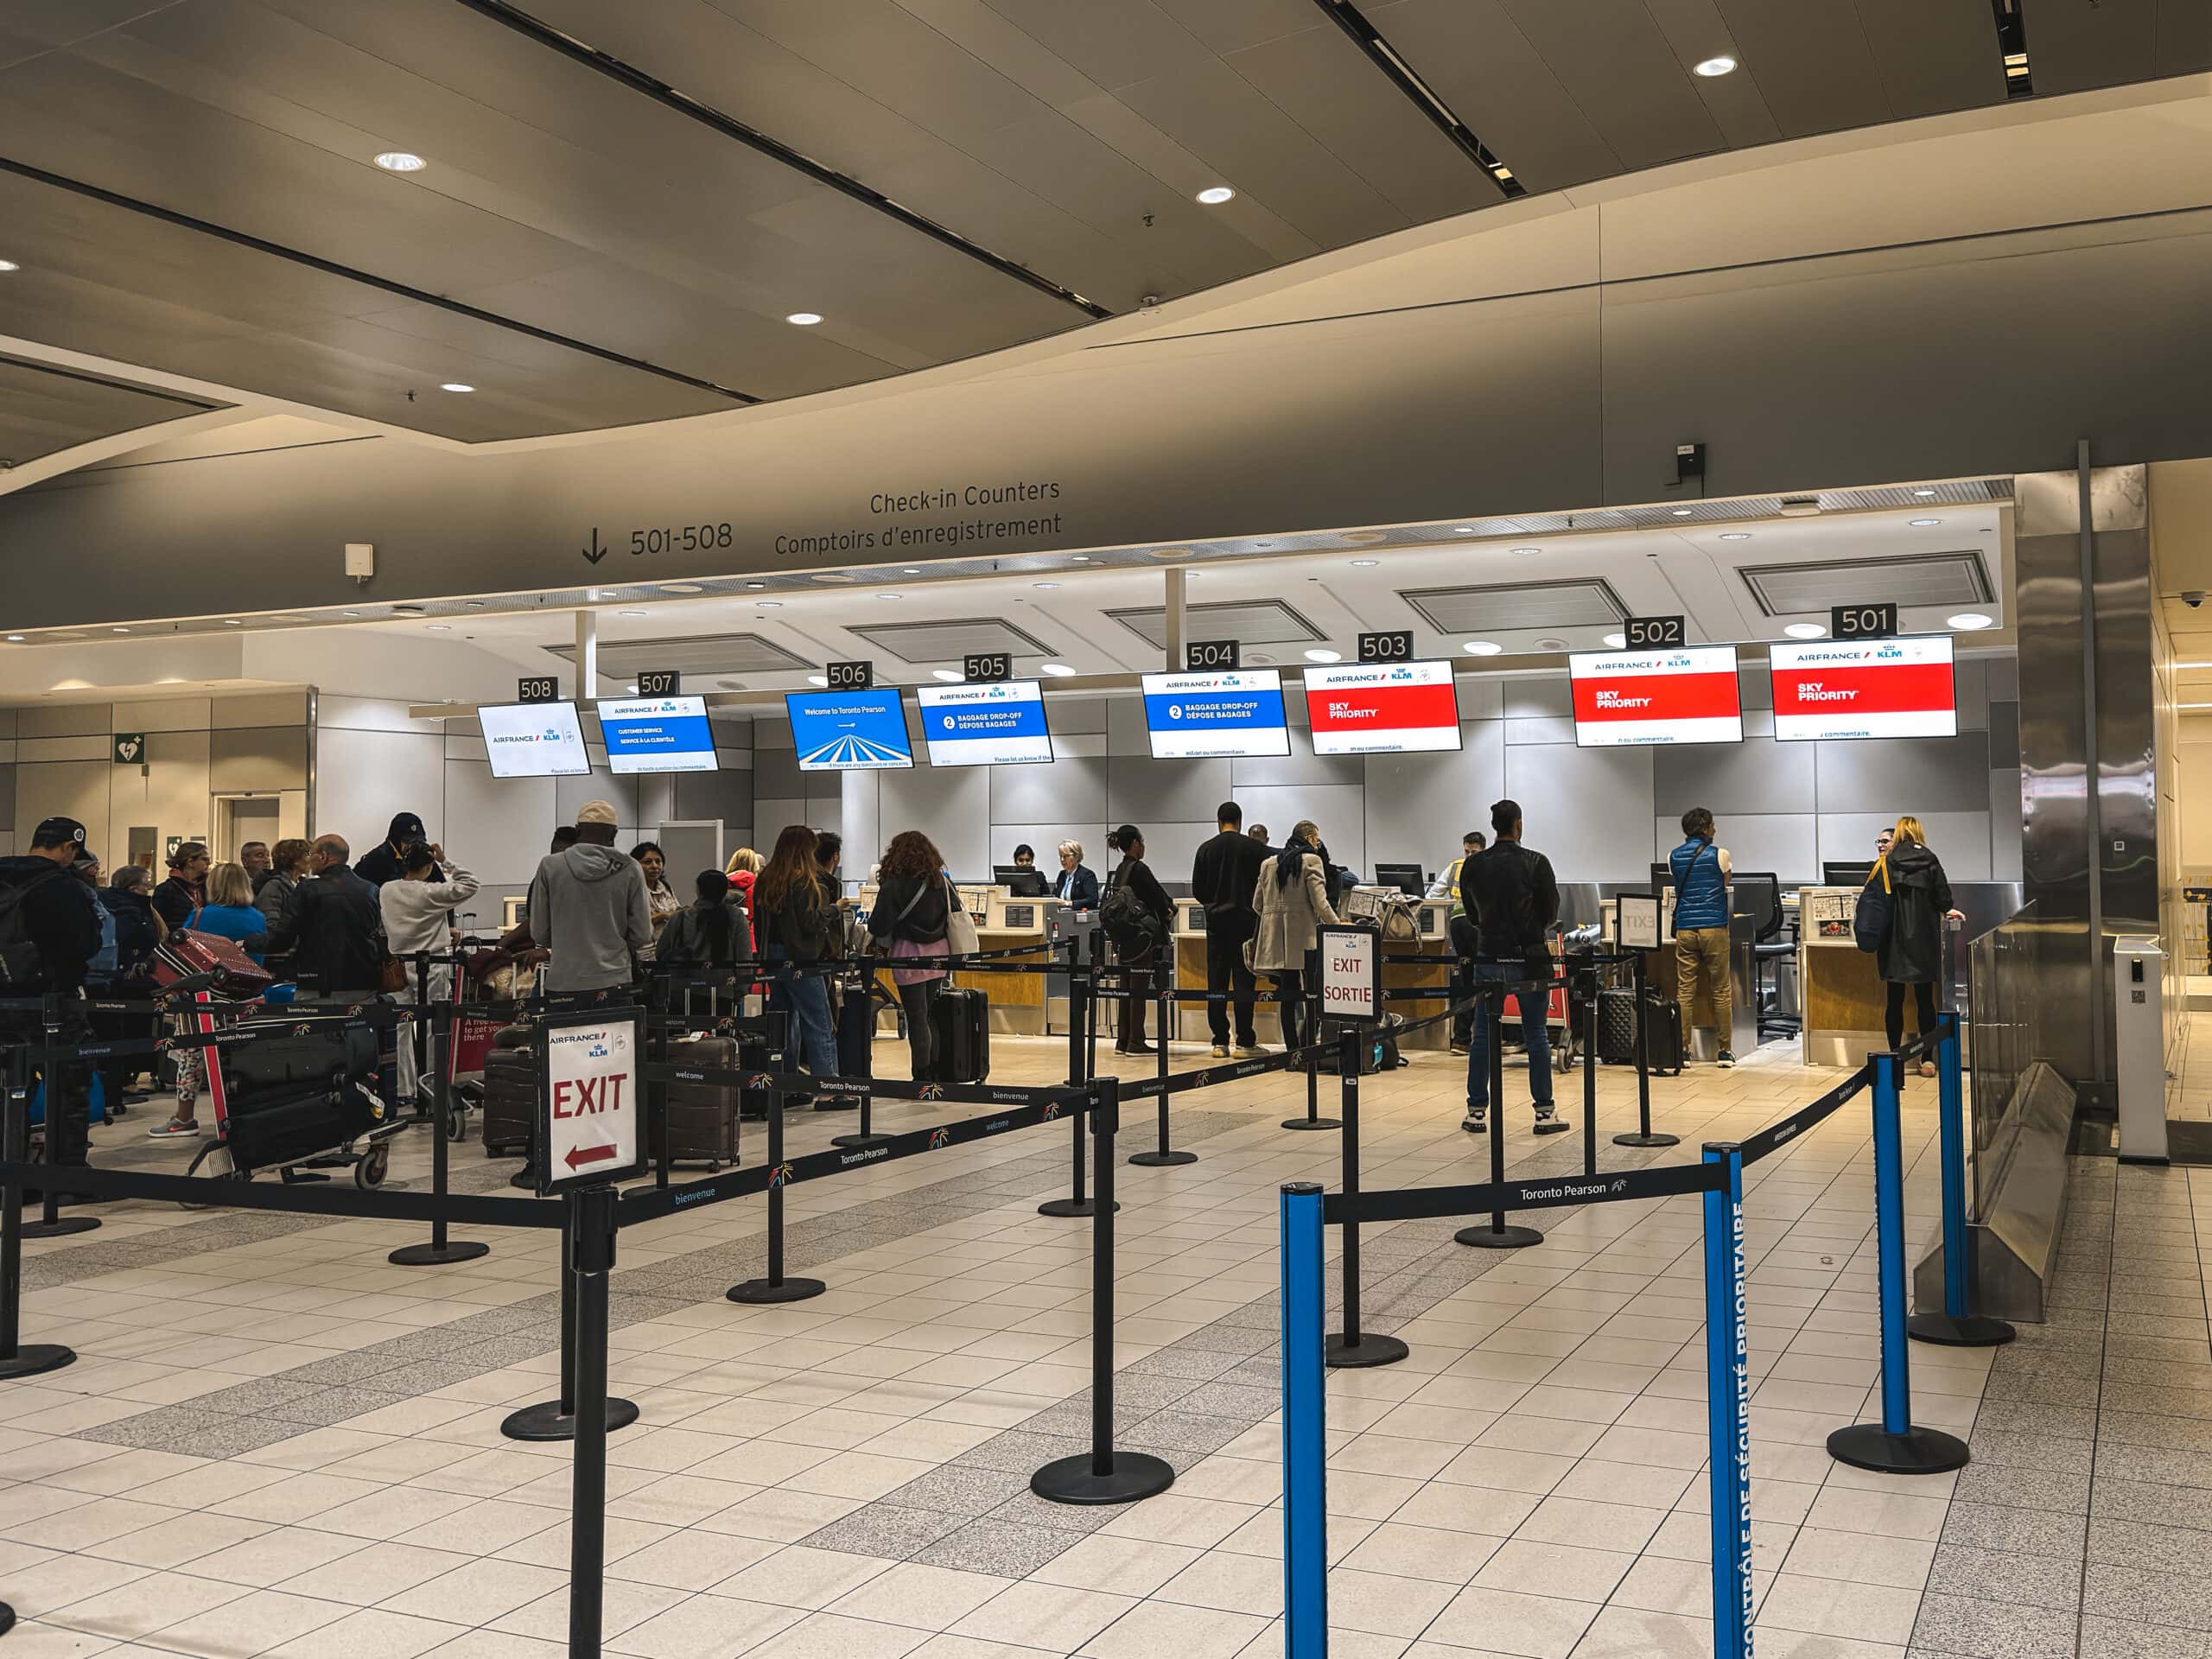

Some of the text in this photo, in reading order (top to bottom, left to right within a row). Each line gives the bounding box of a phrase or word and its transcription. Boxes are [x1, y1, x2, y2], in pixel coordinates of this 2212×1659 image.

[869, 481, 1060, 515] Check-in Counters
[630, 523, 733, 556] 501-508
[774, 513, 1062, 557] Comptoirs d'enregistrement
[1842, 608, 1887, 632] 501
[1630, 620, 1679, 644] 502
[1191, 645, 1233, 665] 504
[1363, 636, 1406, 657] 503
[830, 665, 866, 684] 506
[968, 658, 1004, 677] 505
[521, 681, 551, 698] 508
[642, 675, 672, 692] 507
[1798, 683, 1823, 692] SKY
[1596, 690, 1619, 700] SKY
[1597, 698, 1650, 709] PRIORITY
[1798, 690, 1857, 702] PRIORITY
[804, 708, 830, 716] Welcome
[831, 707, 838, 715] to
[1328, 702, 1350, 711] SKY
[1330, 709, 1377, 719] PRIORITY
[957, 714, 988, 722] BAGGAGE
[985, 720, 1017, 728] BAGAGES
[1333, 957, 1362, 974] EXIT
[1325, 985, 1372, 1003] SORTIE
[215, 1032, 257, 1043] Toronto Pearson
[463, 1033, 485, 1042] there
[474, 1026, 486, 1035] get
[550, 1033, 600, 1046] AIRFRANCE
[588, 1049, 608, 1058] KLM
[676, 1070, 704, 1081] welcome
[819, 1080, 871, 1092] Toronto Pearson
[553, 1073, 627, 1120] EXIT
[993, 1090, 1029, 1101] bienvenue
[841, 1147, 887, 1166] Toronto Pearson
[675, 1186, 715, 1205] bienvenue
[1521, 1183, 1606, 1200] Toronto Pearson
[1740, 1490, 1751, 1522] DE
